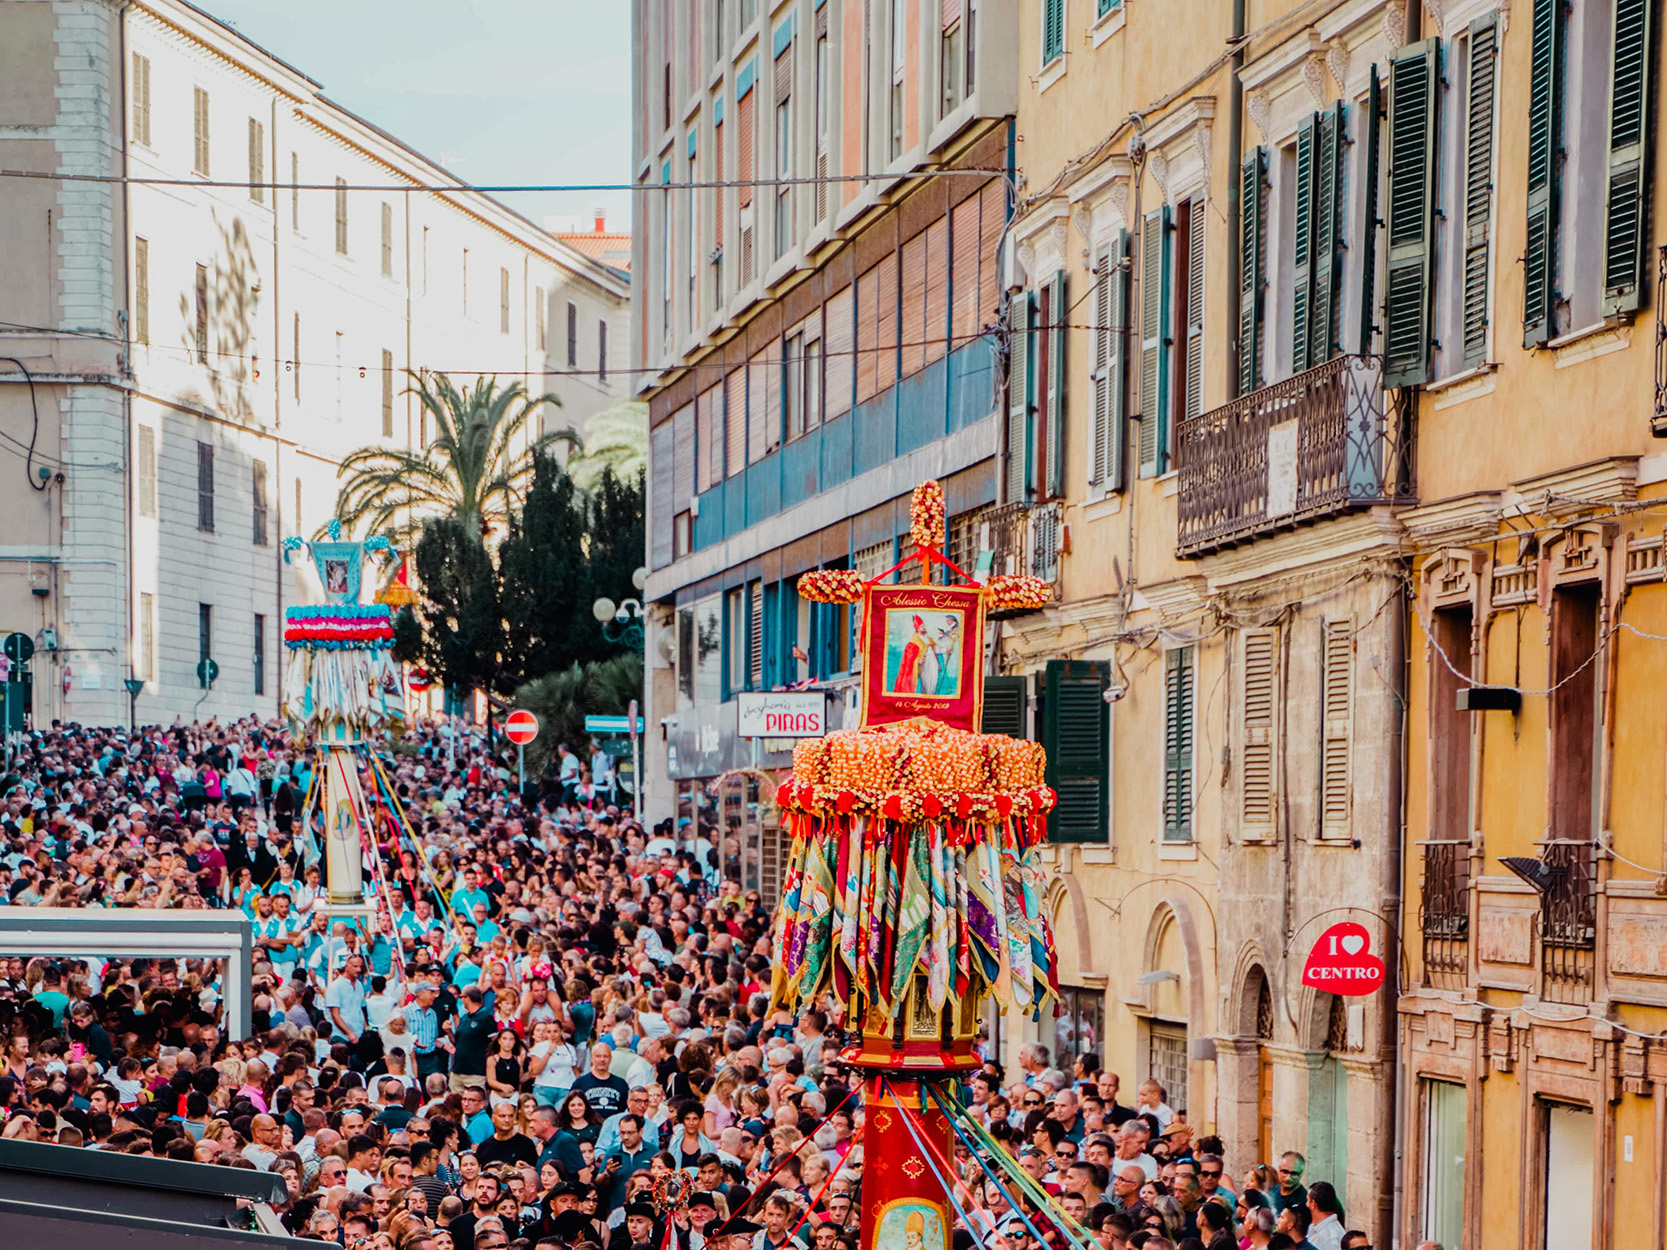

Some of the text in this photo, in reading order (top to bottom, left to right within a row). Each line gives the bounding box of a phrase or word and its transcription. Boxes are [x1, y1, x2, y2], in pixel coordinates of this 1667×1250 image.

[880, 592, 970, 607] Alessio Chessa
[766, 713, 820, 732] PIRAS
[1328, 936, 1338, 956] I
[1307, 967, 1380, 980] CENTRO
